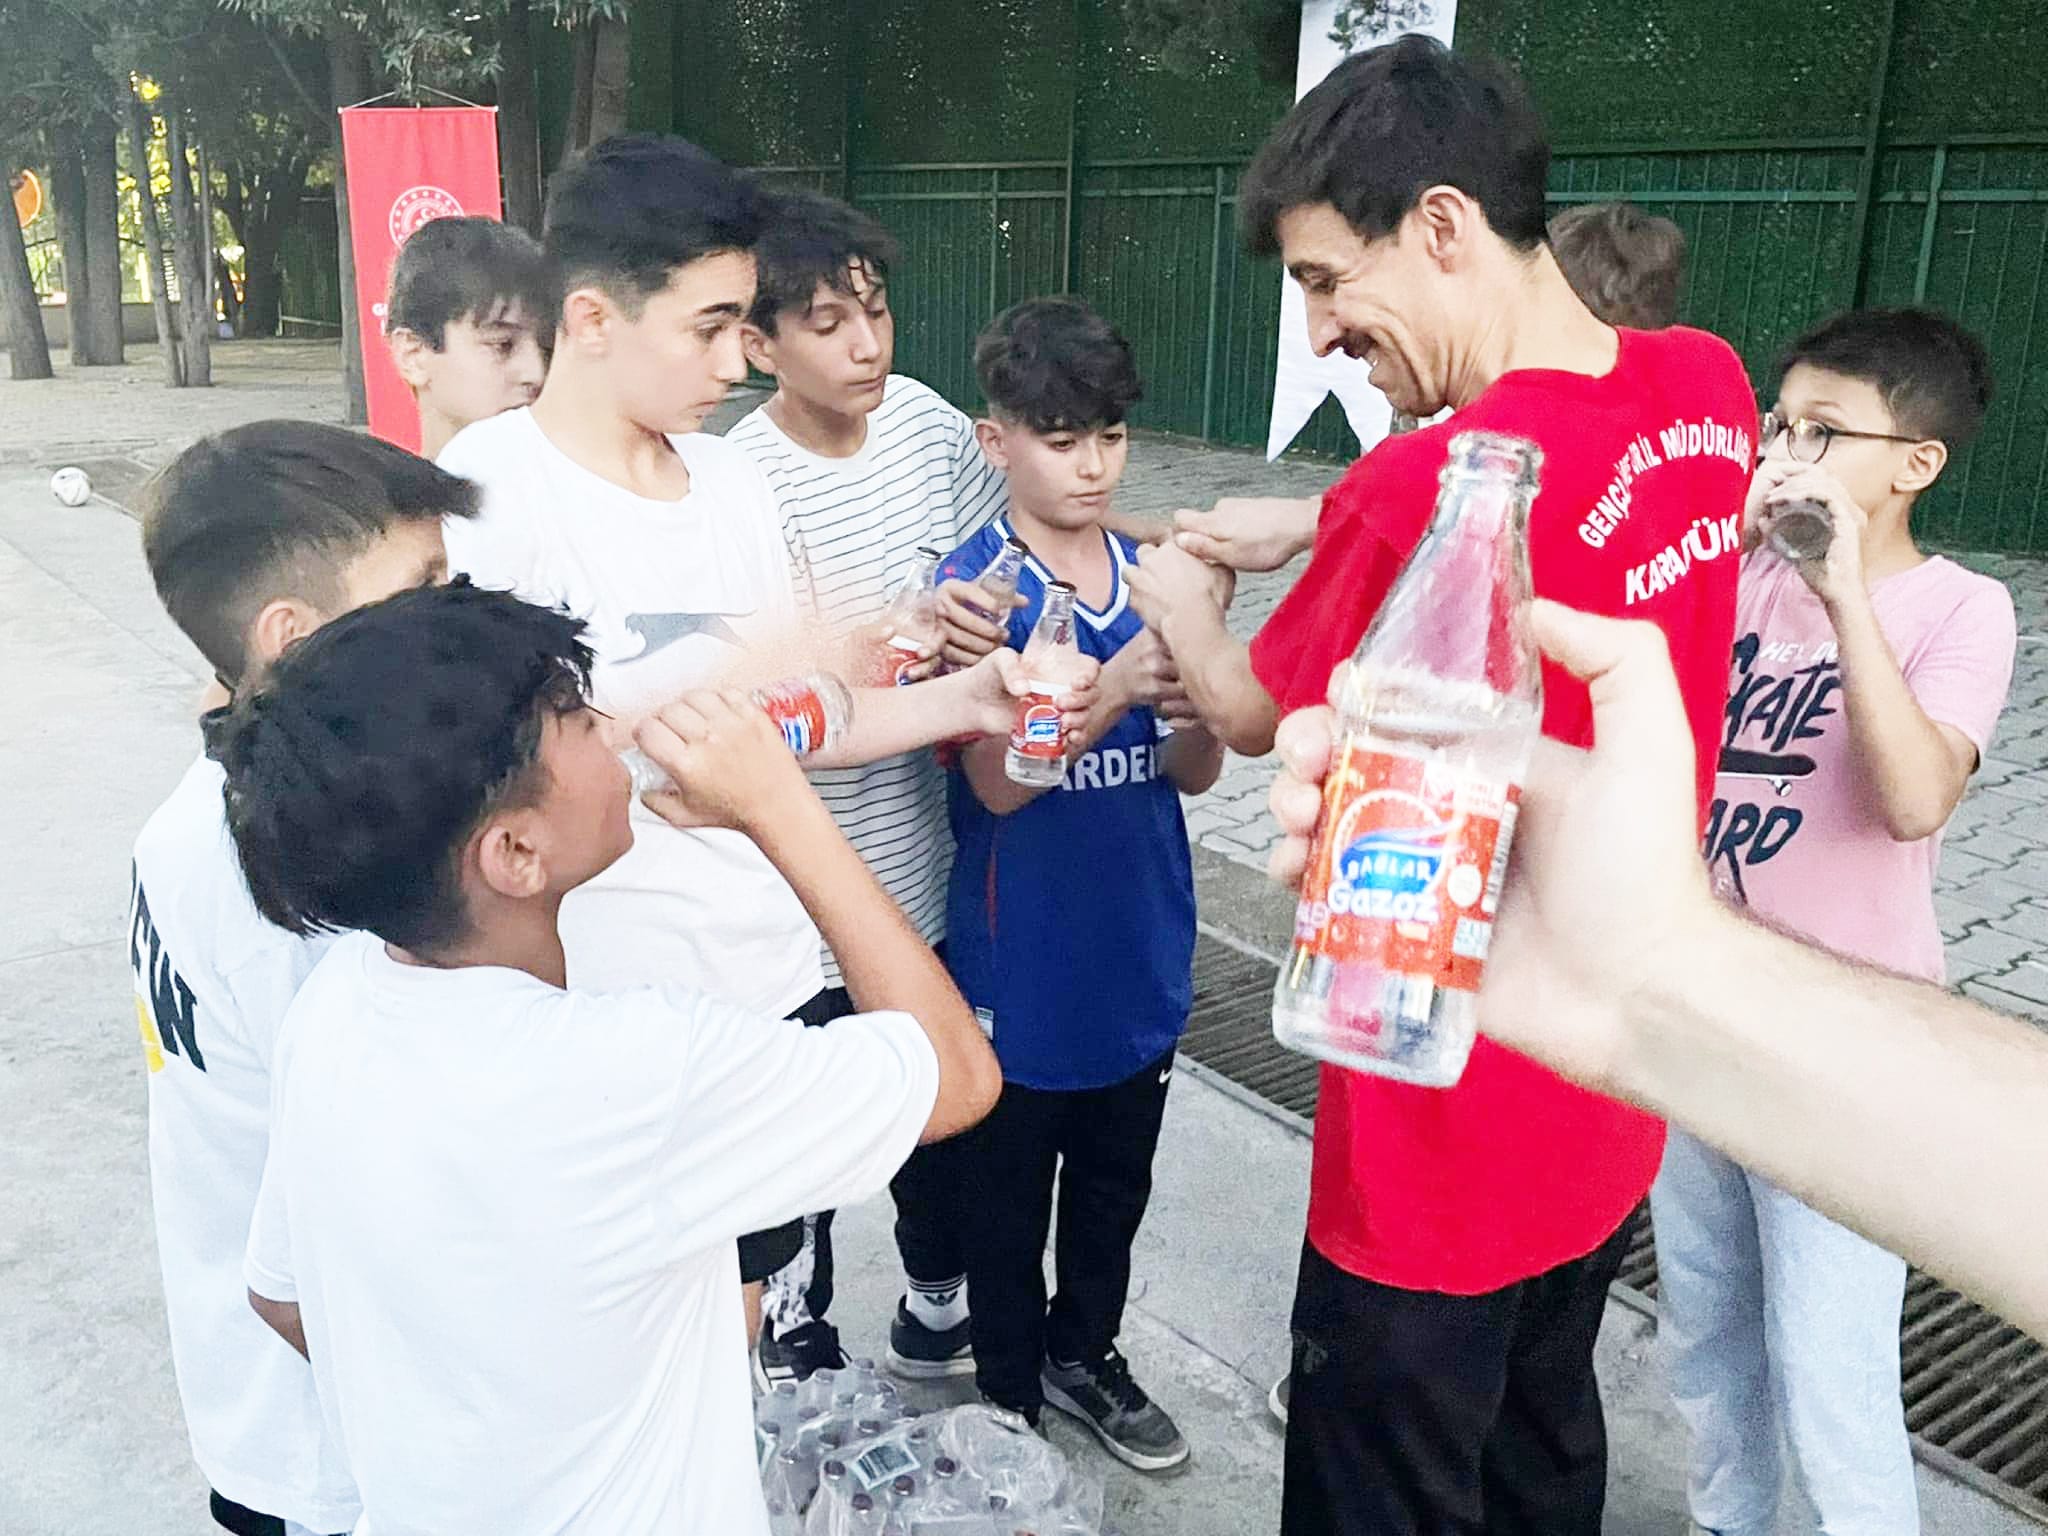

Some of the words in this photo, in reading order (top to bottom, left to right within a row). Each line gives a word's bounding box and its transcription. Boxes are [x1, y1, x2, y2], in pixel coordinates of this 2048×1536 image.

[1625, 513, 1740, 605] KARAÜK
[1726, 659, 1841, 752] KATE
[1327, 880, 1440, 923] Gazoz
